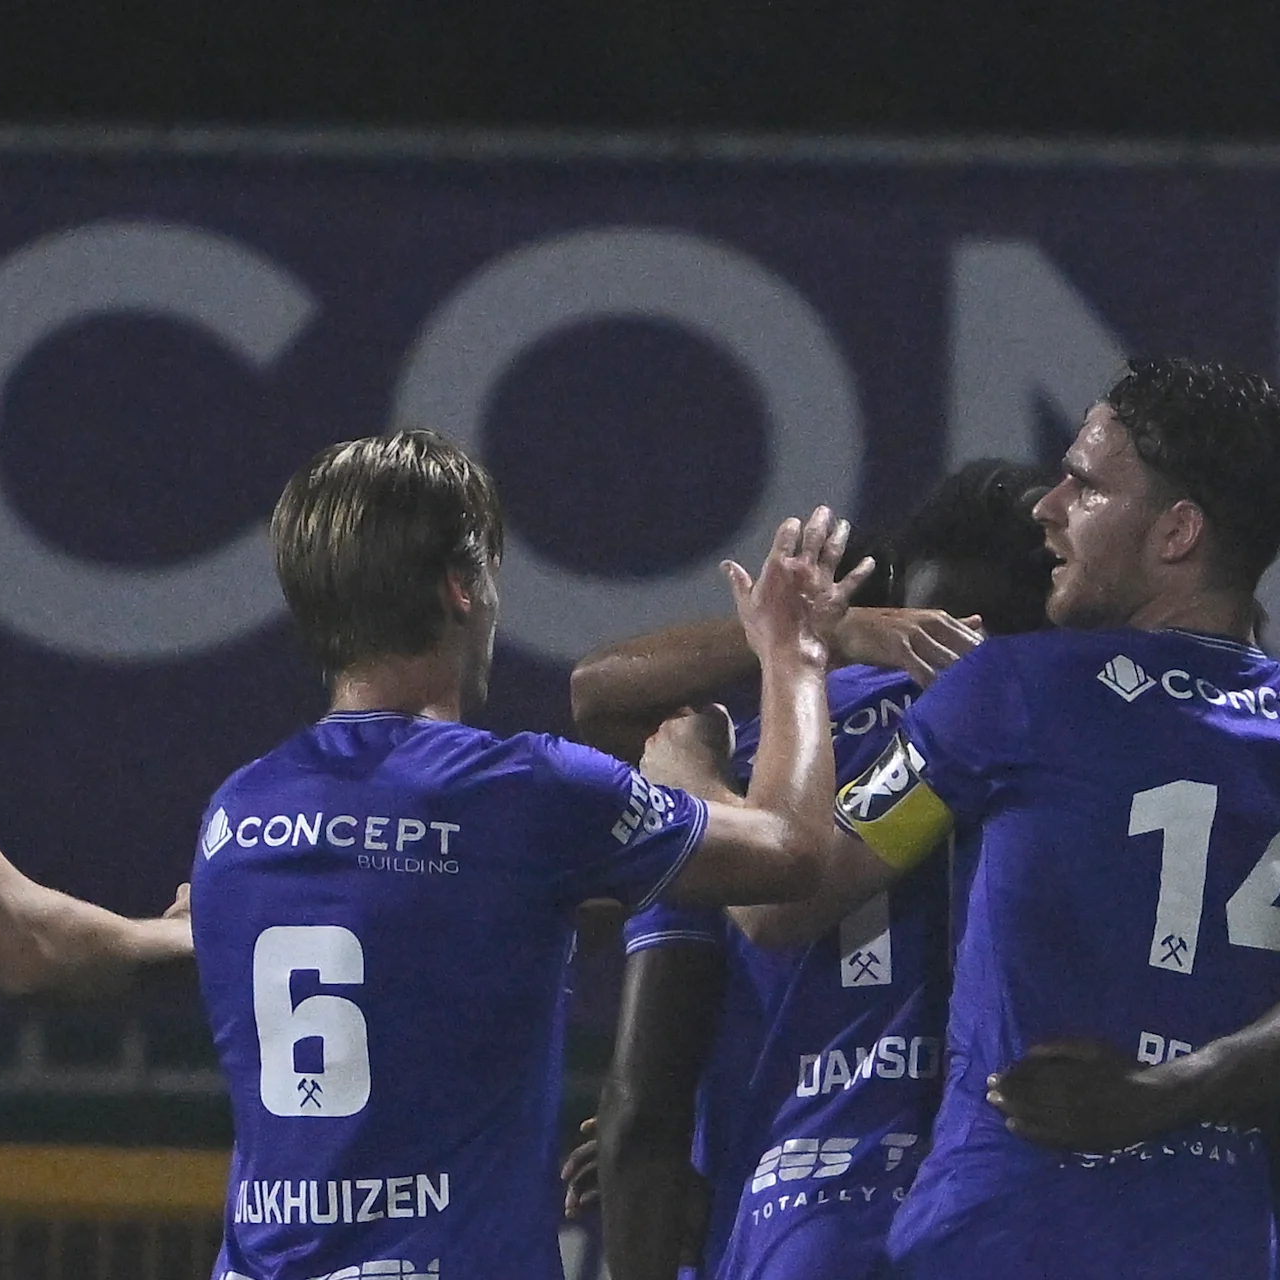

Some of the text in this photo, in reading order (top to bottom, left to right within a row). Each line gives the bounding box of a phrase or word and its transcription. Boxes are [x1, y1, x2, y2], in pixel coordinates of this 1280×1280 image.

[235, 811, 461, 855] CONCEPT
[357, 854, 460, 875] BUILDING
[253, 926, 372, 1117] 6
[752, 1186, 877, 1226] TOTALLY
